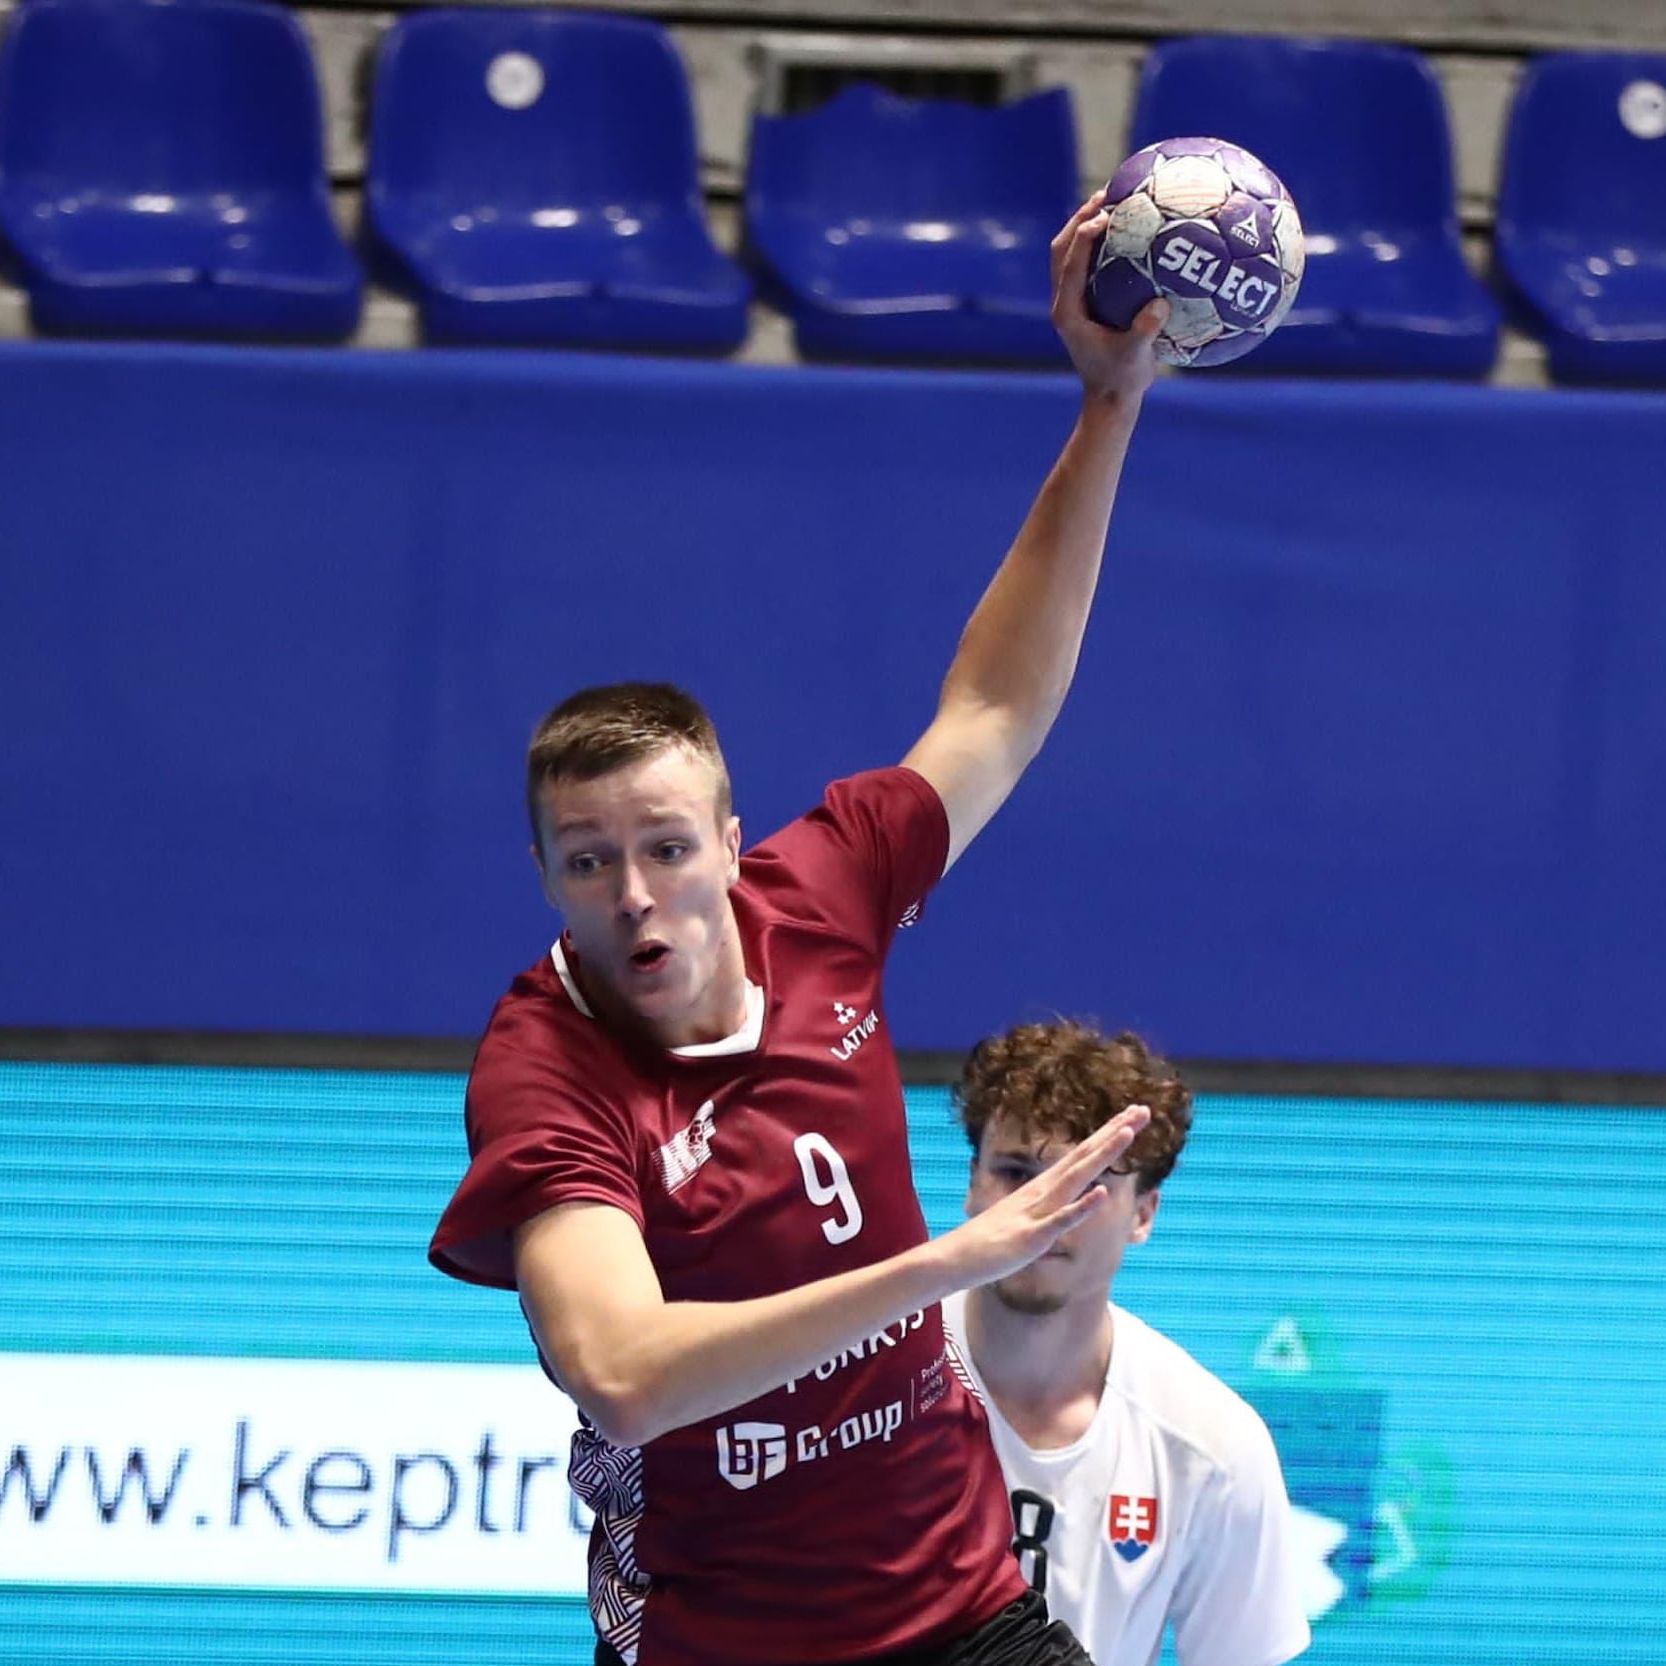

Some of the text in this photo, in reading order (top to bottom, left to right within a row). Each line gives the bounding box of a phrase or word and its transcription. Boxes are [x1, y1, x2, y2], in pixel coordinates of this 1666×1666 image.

[1157, 236, 1278, 315] SELECT
[1230, 226, 1260, 248] SELECT
[793, 1131, 863, 1245] 9
